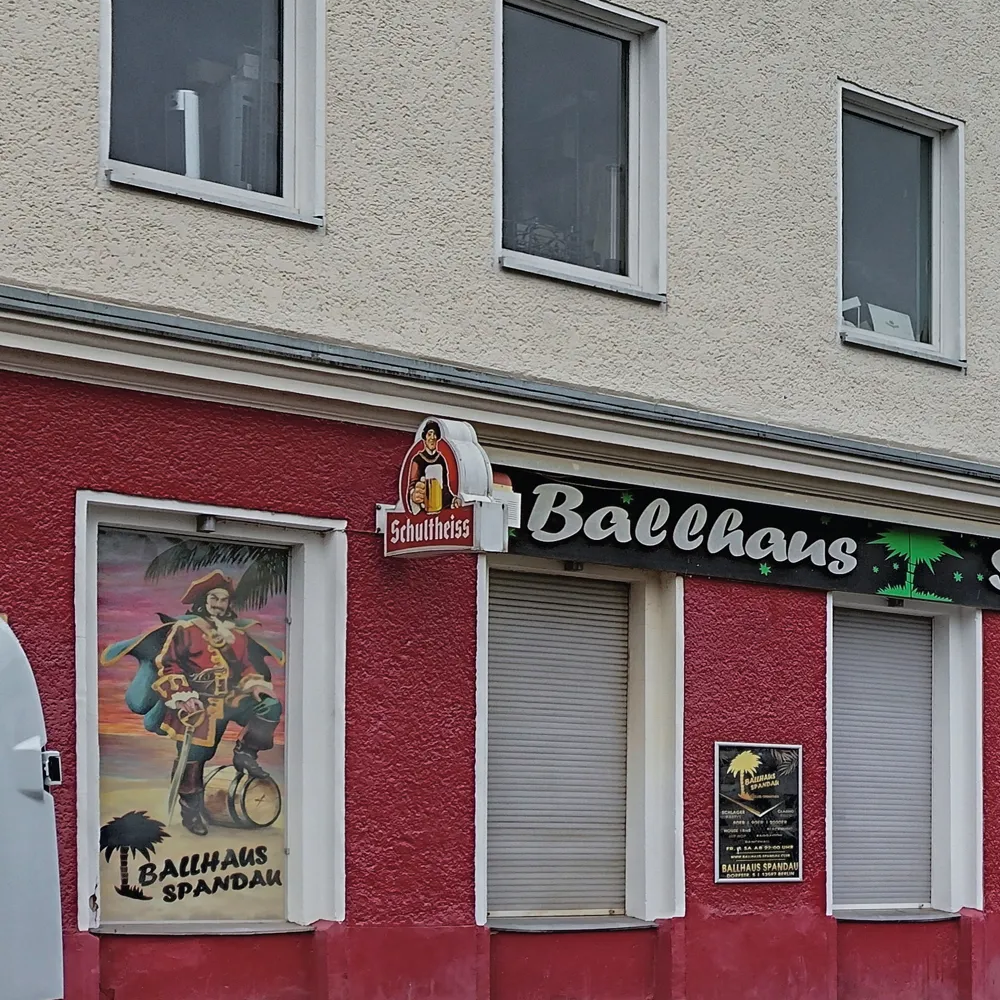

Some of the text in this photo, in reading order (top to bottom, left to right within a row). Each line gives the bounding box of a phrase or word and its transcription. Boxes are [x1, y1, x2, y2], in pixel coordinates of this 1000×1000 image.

[390, 514, 470, 544] Schultheiss
[527, 482, 857, 576] Ballhaus
[138, 845, 268, 887] BALLHAUS
[721, 862, 799, 873] BALLHAUS SPANDAU
[162, 869, 282, 902] SPANDAU
